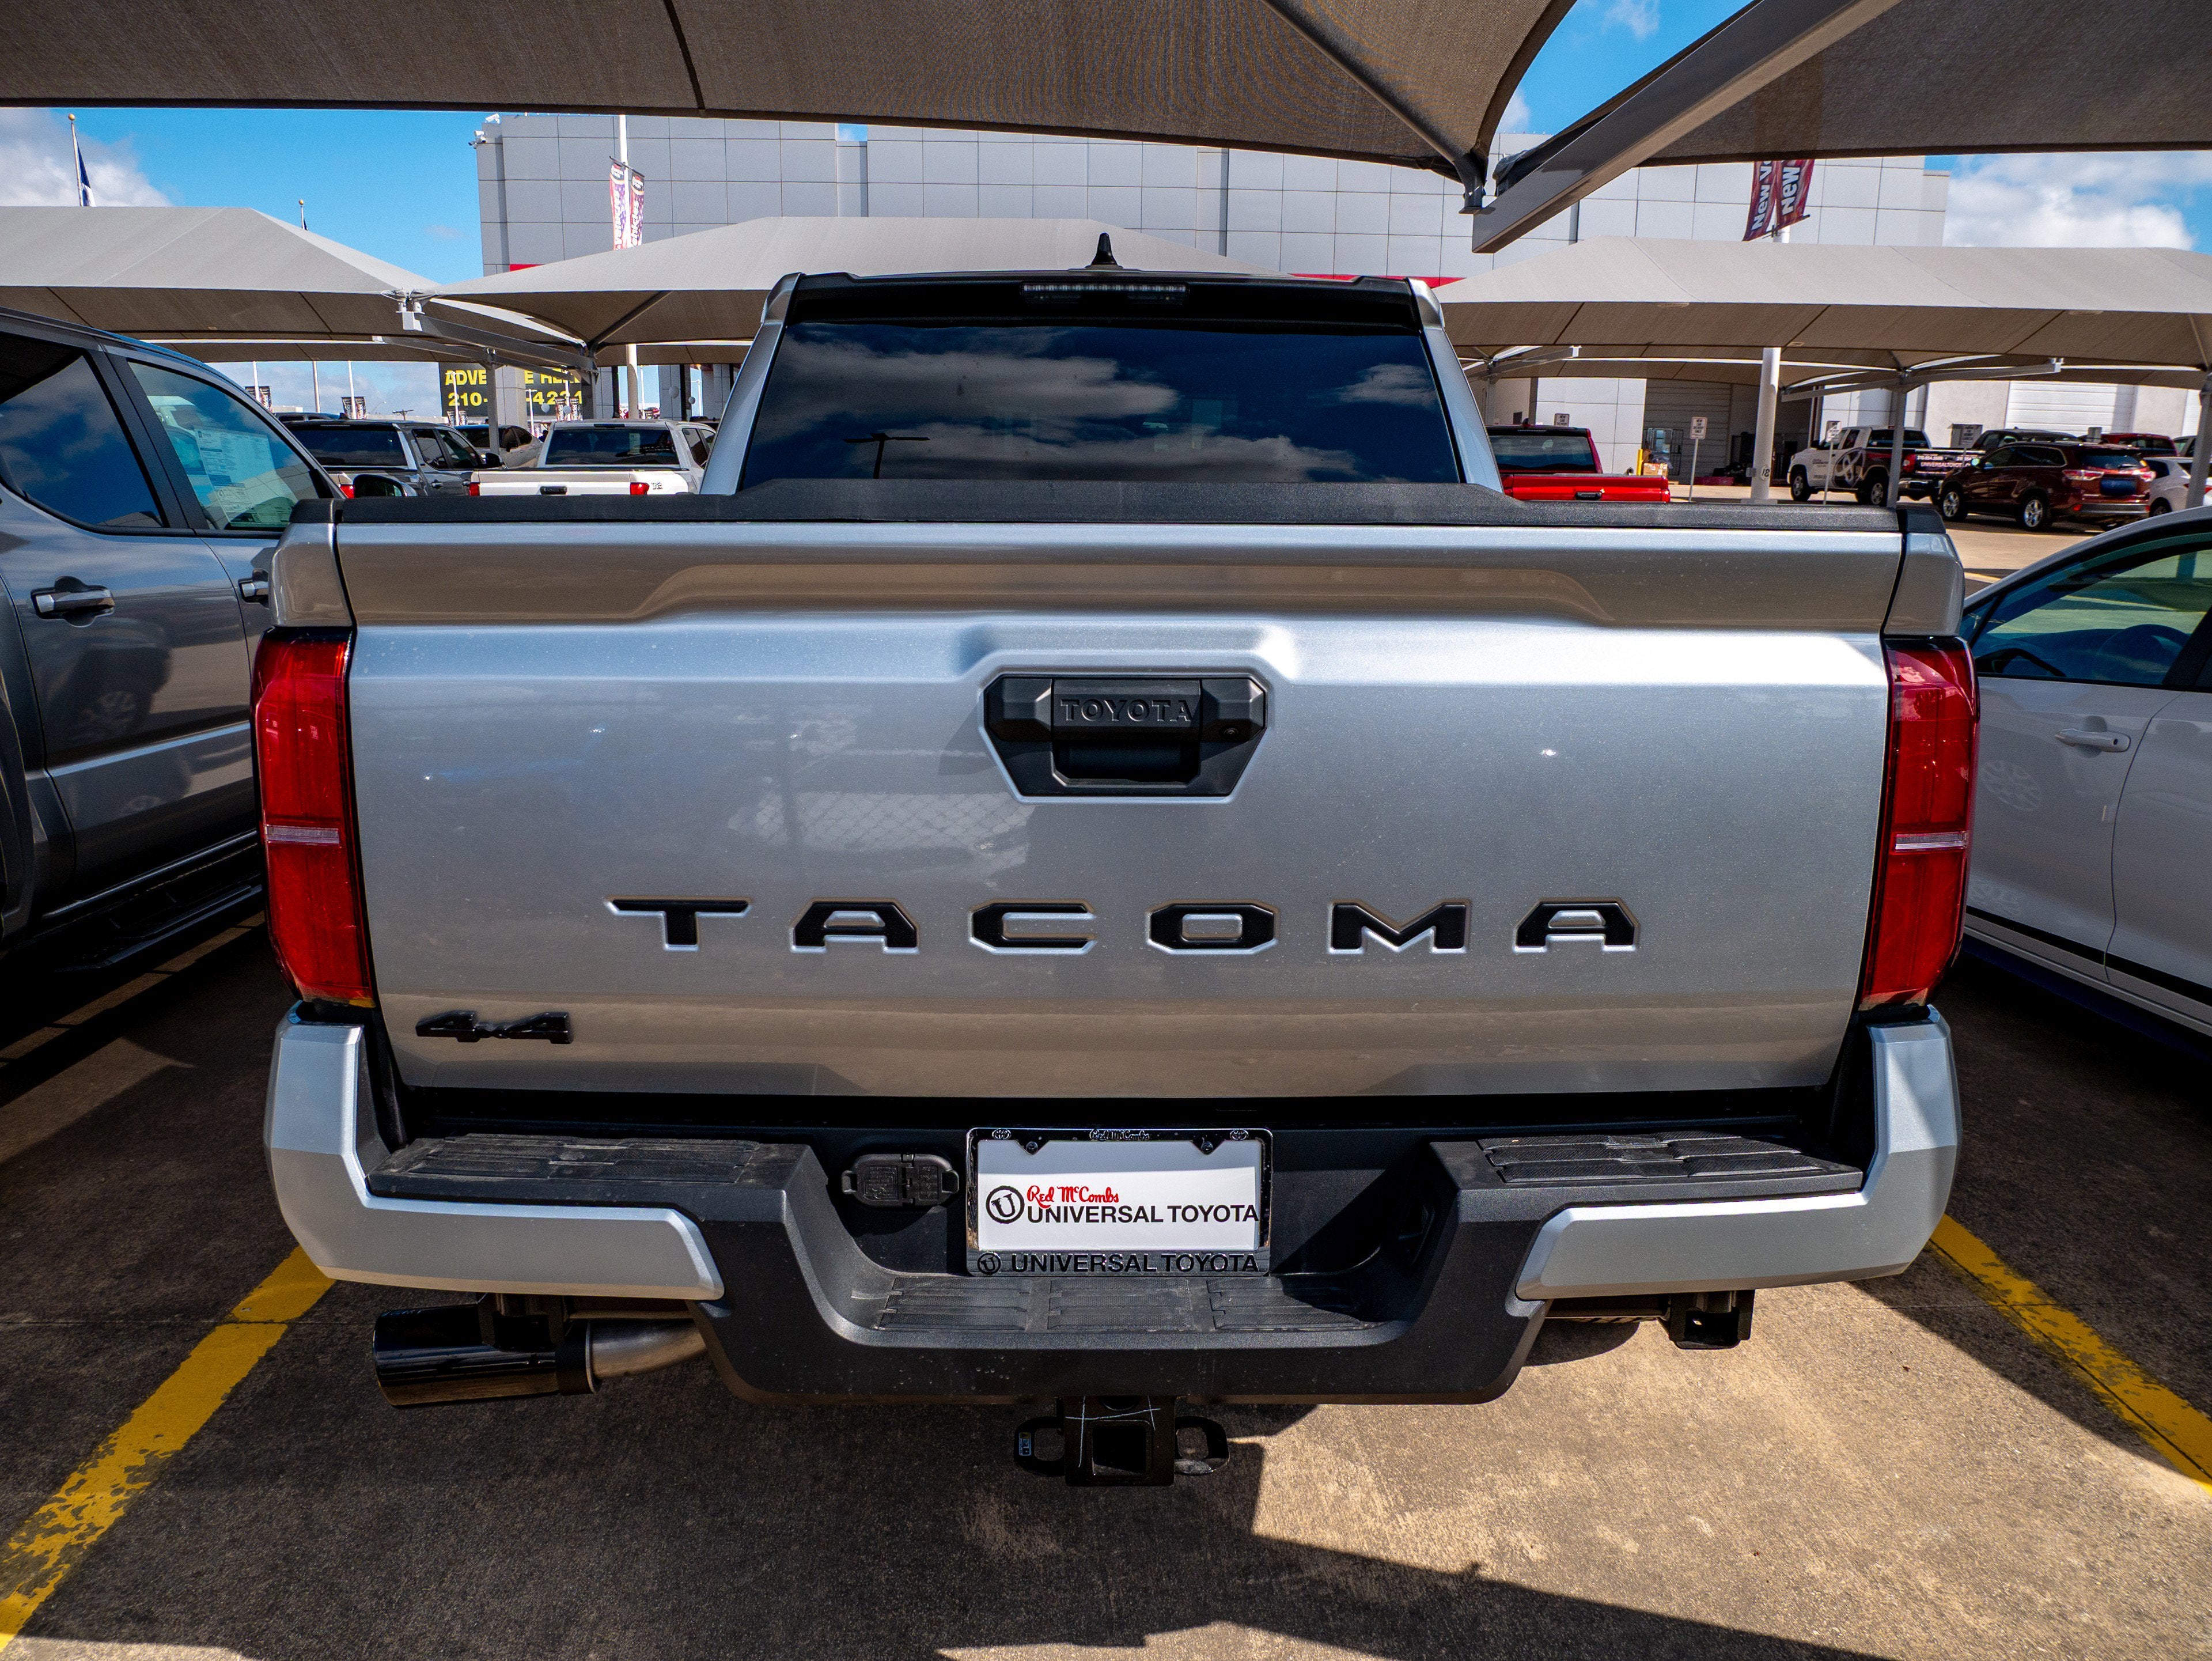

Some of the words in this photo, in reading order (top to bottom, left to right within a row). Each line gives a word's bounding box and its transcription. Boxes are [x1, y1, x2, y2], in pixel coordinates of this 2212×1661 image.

[1781, 167, 1800, 215] New
[1751, 185, 1771, 230] New
[631, 200, 639, 246] ehicles
[1060, 699, 1194, 722] TOYOTA
[605, 898, 1640, 955] TACOMA
[1089, 1129, 1107, 1141] Red
[1027, 1185, 1055, 1209] Red
[1056, 1186, 1119, 1203] McCombs
[1027, 1205, 1163, 1223] UNIVERSAL
[1167, 1204, 1259, 1223] TOYOTA
[1012, 1253, 1158, 1273] UNIVERSAL
[1160, 1253, 1259, 1273] TOYOTA
